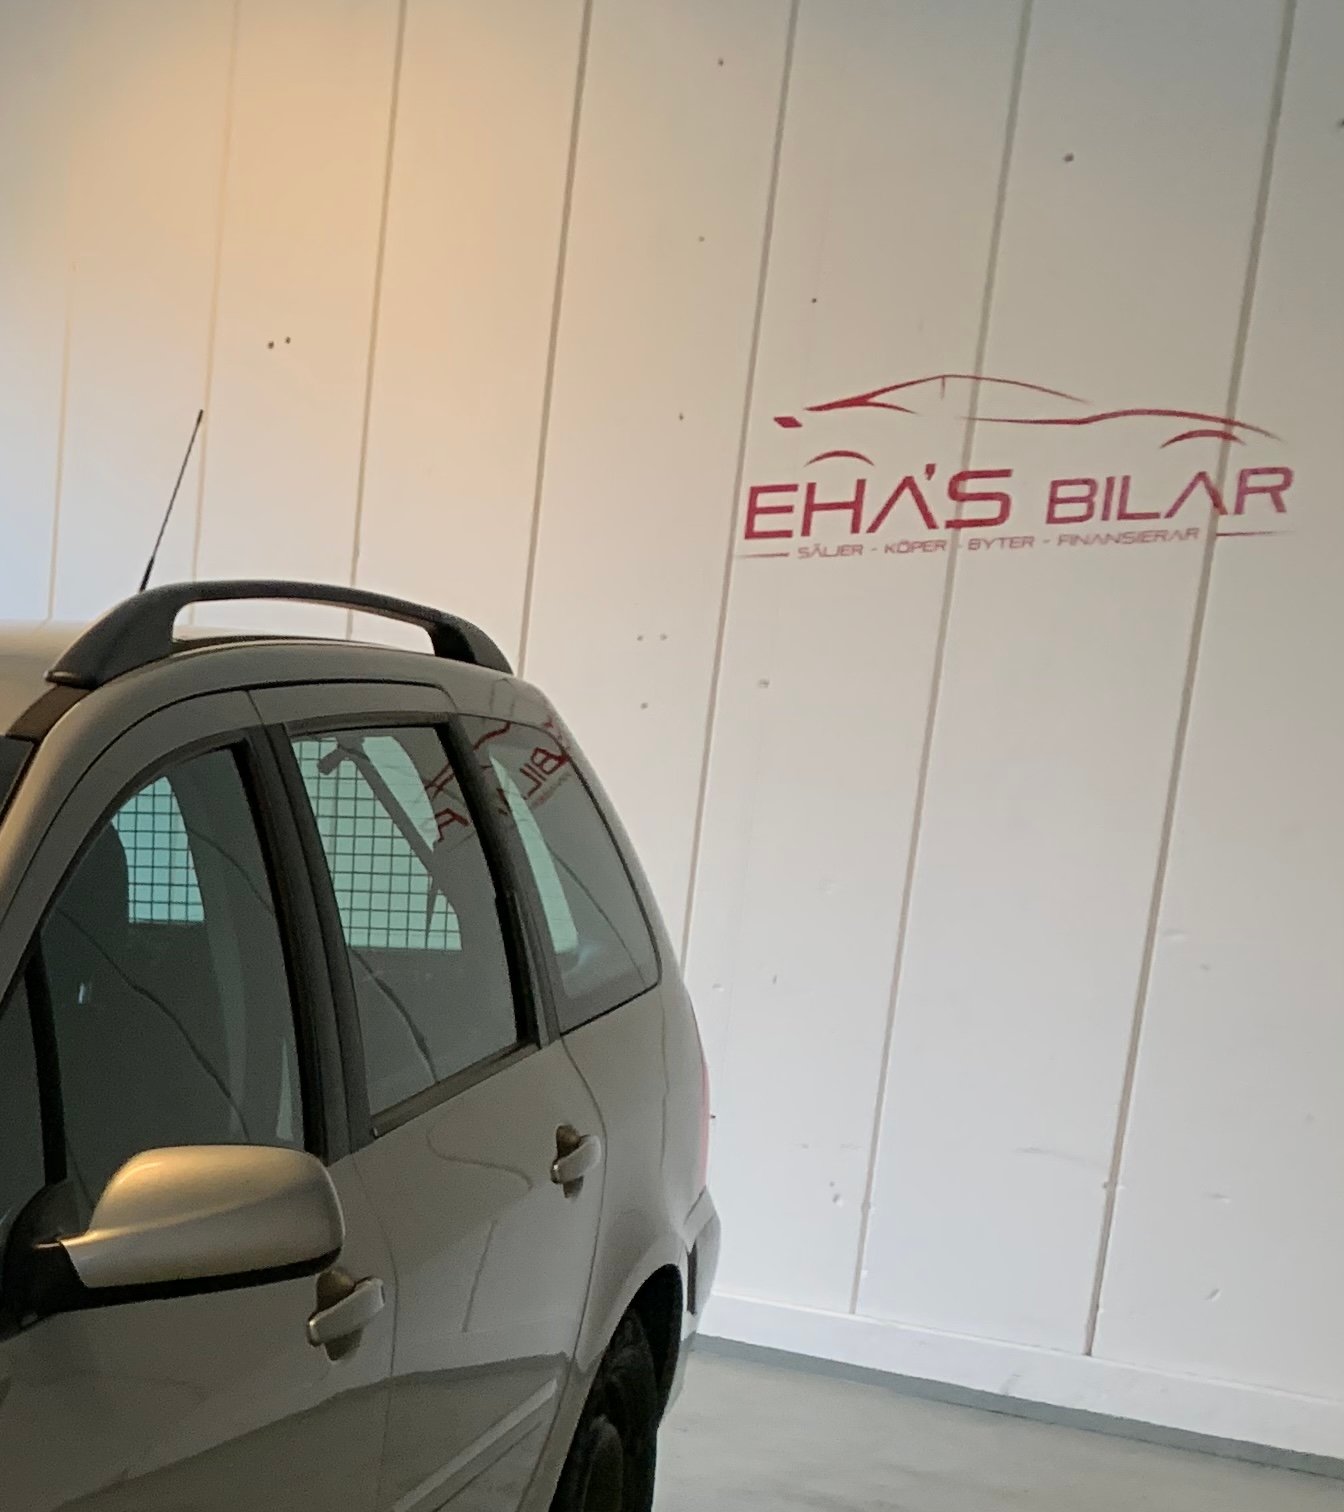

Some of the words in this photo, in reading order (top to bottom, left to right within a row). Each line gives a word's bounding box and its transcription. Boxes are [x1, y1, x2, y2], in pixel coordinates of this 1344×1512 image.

[743, 463, 1013, 540] EHA'S
[1045, 466, 1294, 525] BILAR
[883, 538, 947, 555] KÖPER
[967, 535, 1035, 551] BYTER
[1056, 526, 1201, 547] FINANSIERAR
